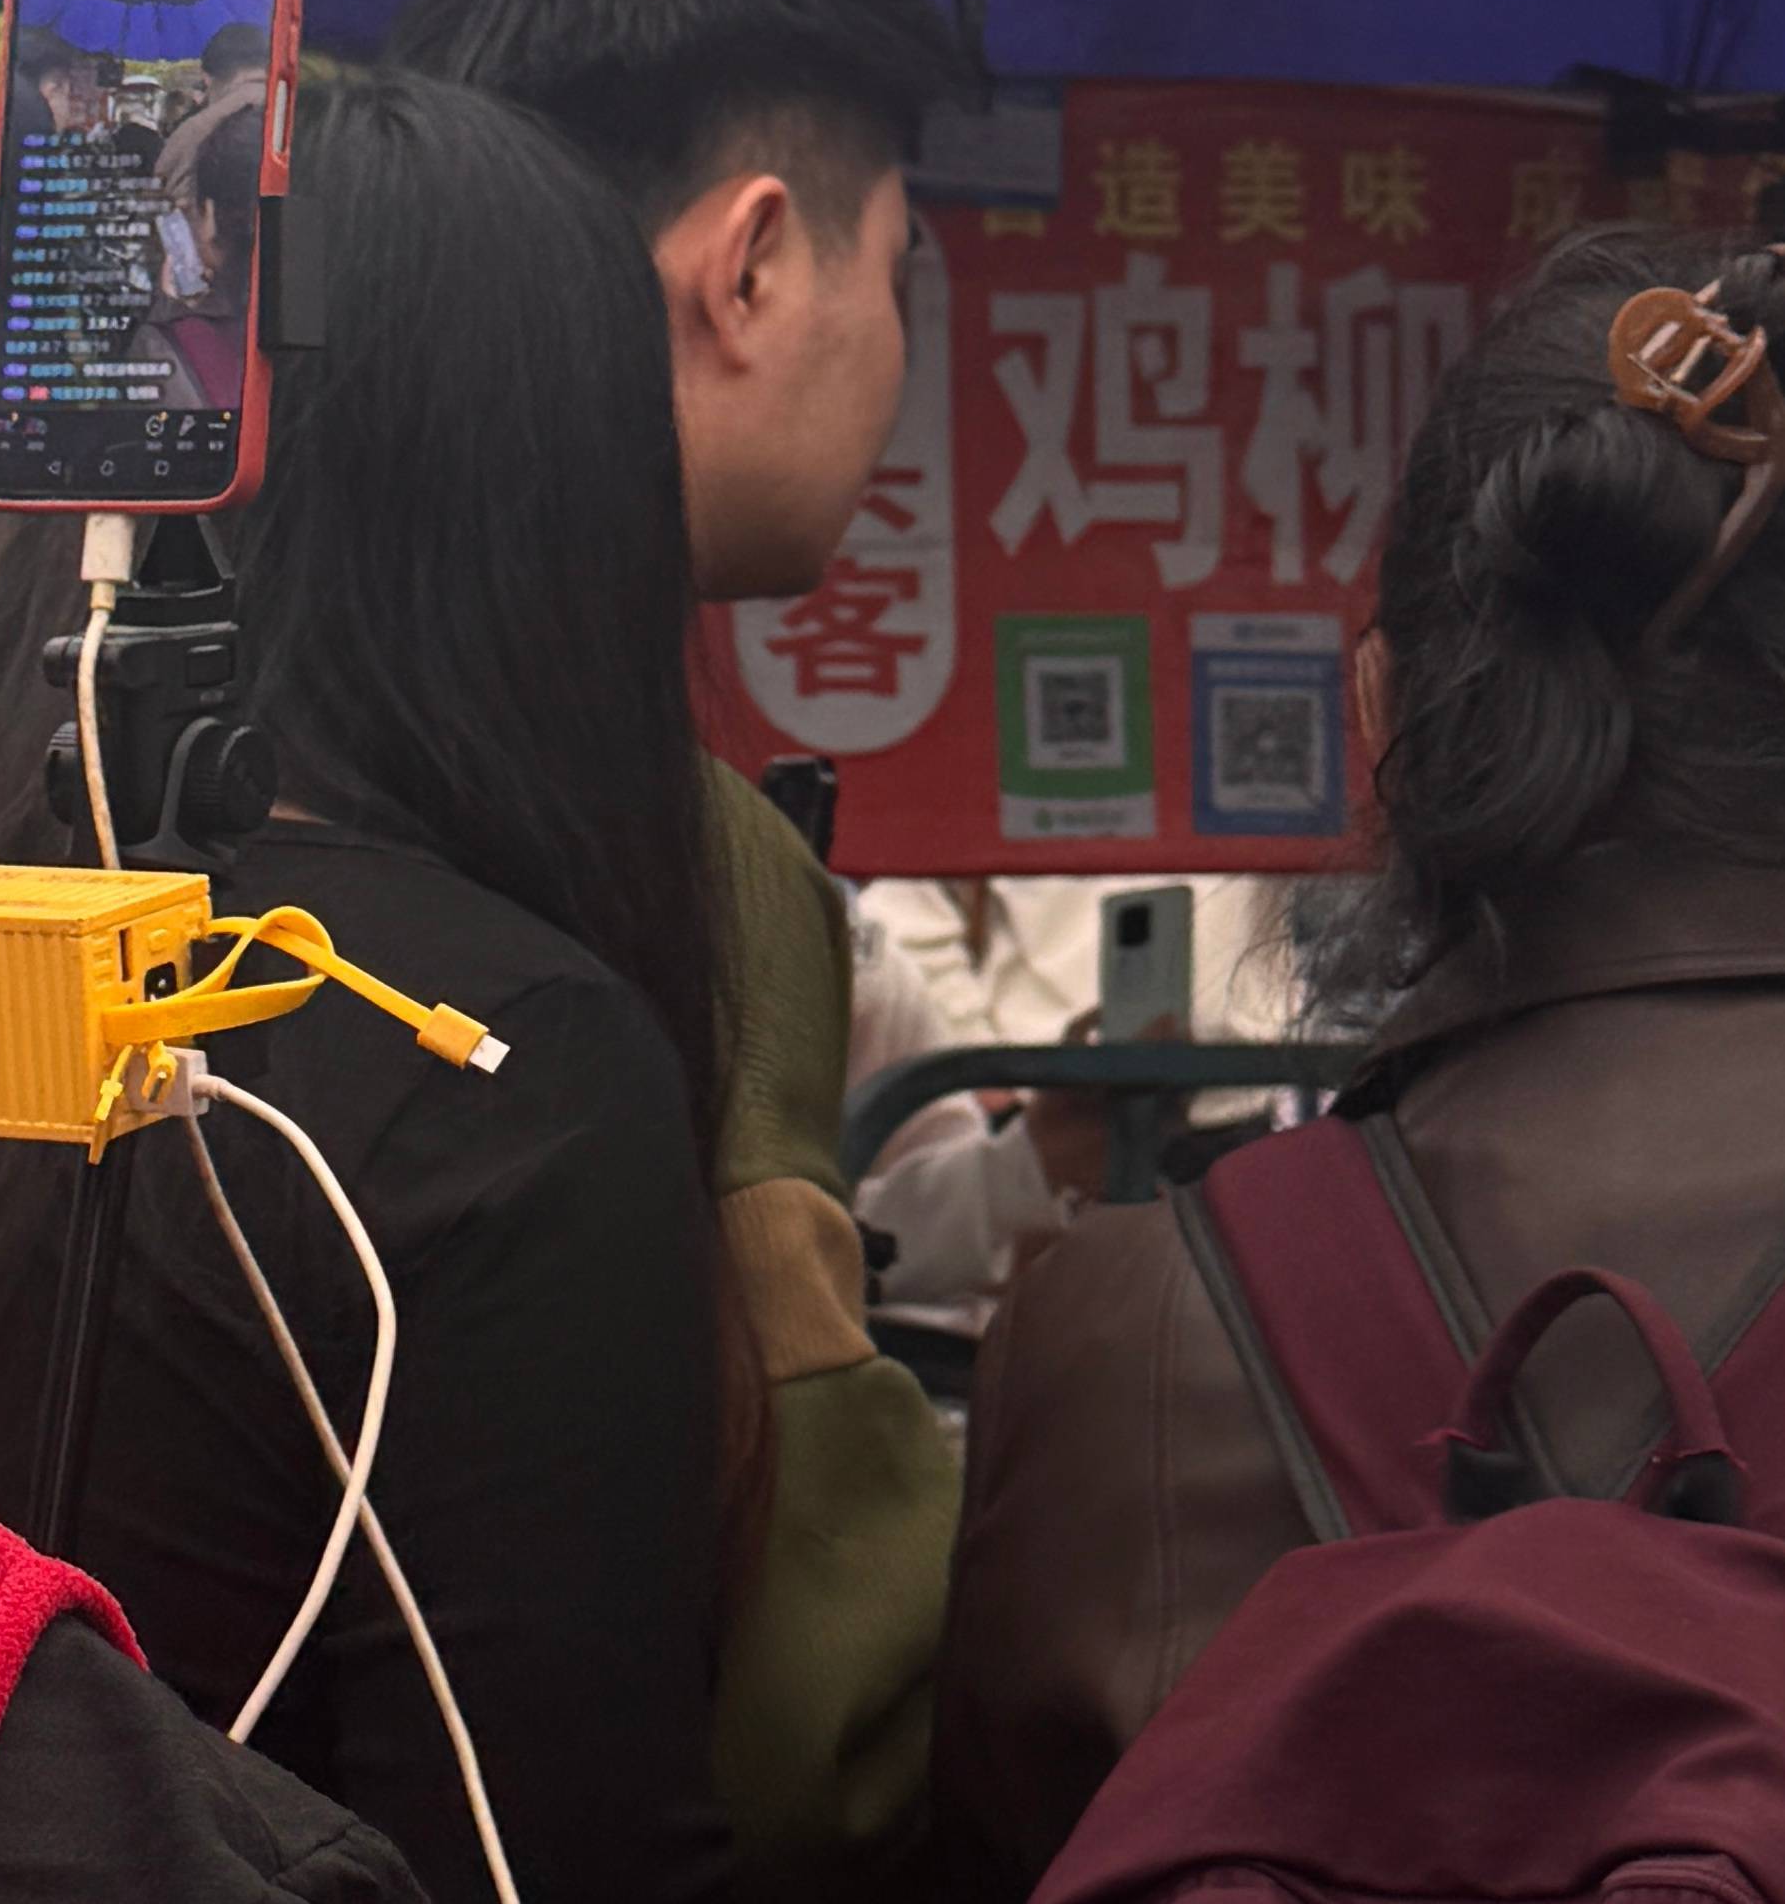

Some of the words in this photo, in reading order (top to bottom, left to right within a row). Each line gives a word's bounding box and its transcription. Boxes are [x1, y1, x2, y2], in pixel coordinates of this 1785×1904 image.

[983, 136, 1430, 244] 造美味
[988, 252, 1471, 591] 鸡柳
